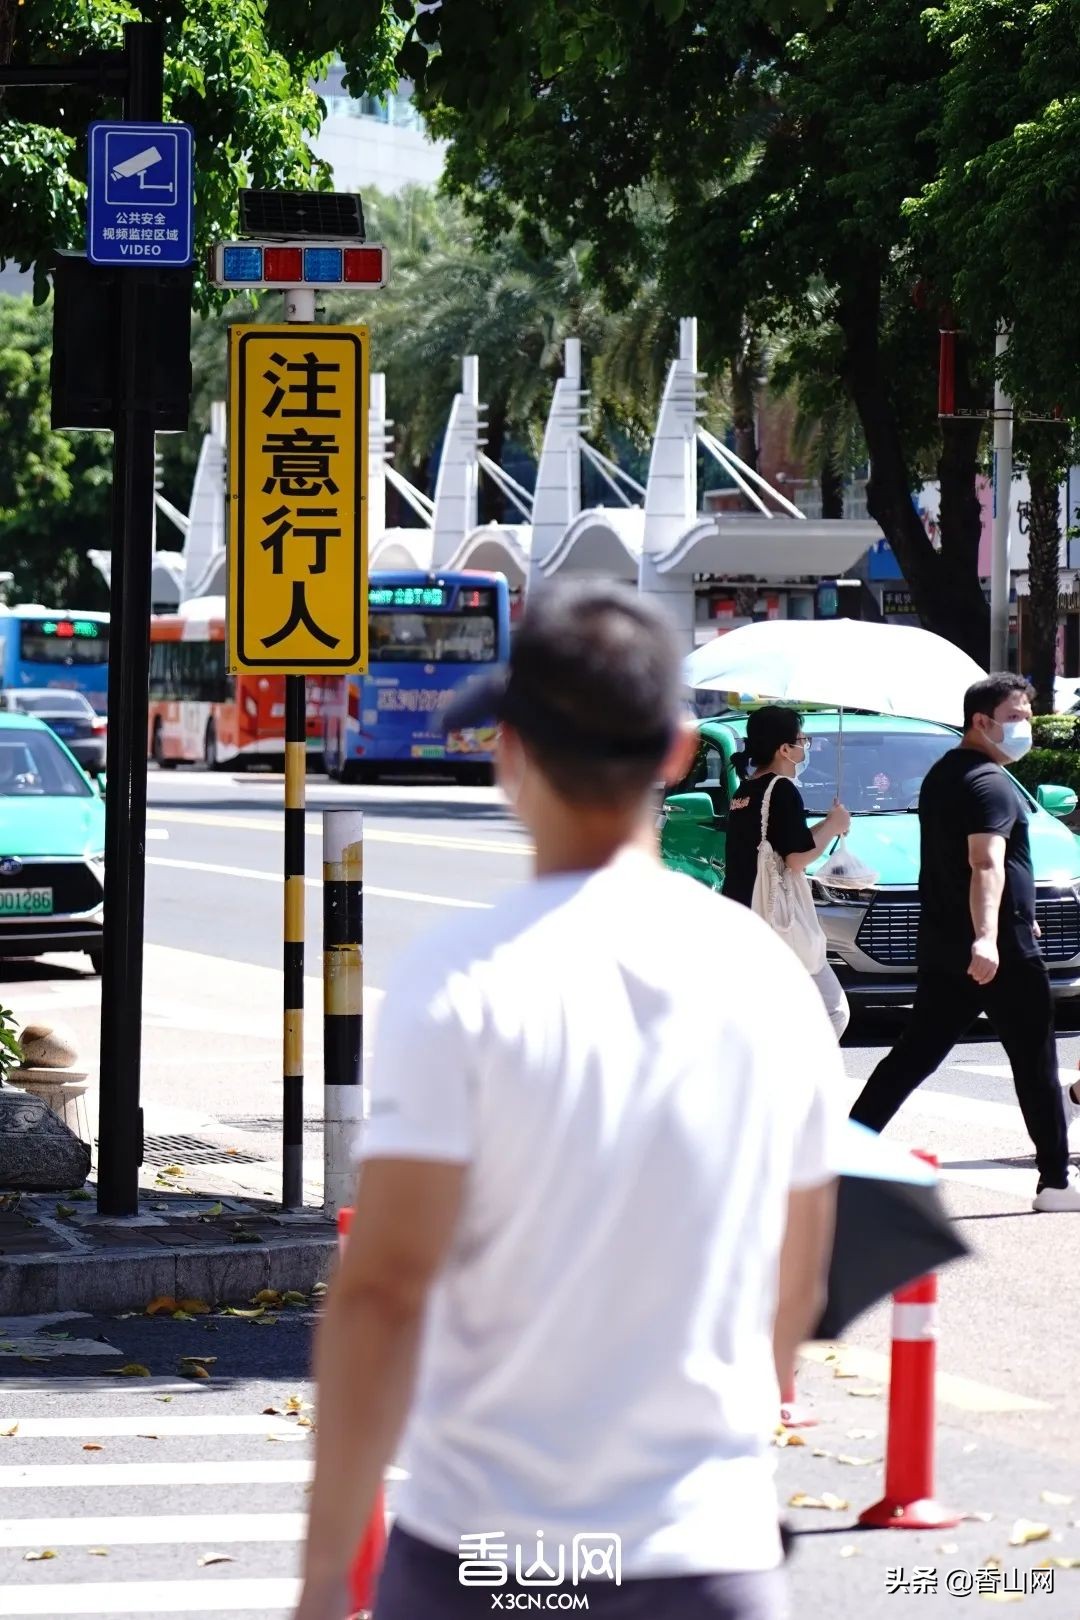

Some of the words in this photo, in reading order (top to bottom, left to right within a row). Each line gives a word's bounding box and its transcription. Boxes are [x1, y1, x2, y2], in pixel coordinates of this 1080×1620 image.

[116, 212, 166, 225] 公共安全
[102, 227, 179, 241] 视频监控区域
[119, 244, 162, 256] VIDEO
[259, 351, 342, 650] 注意行人
